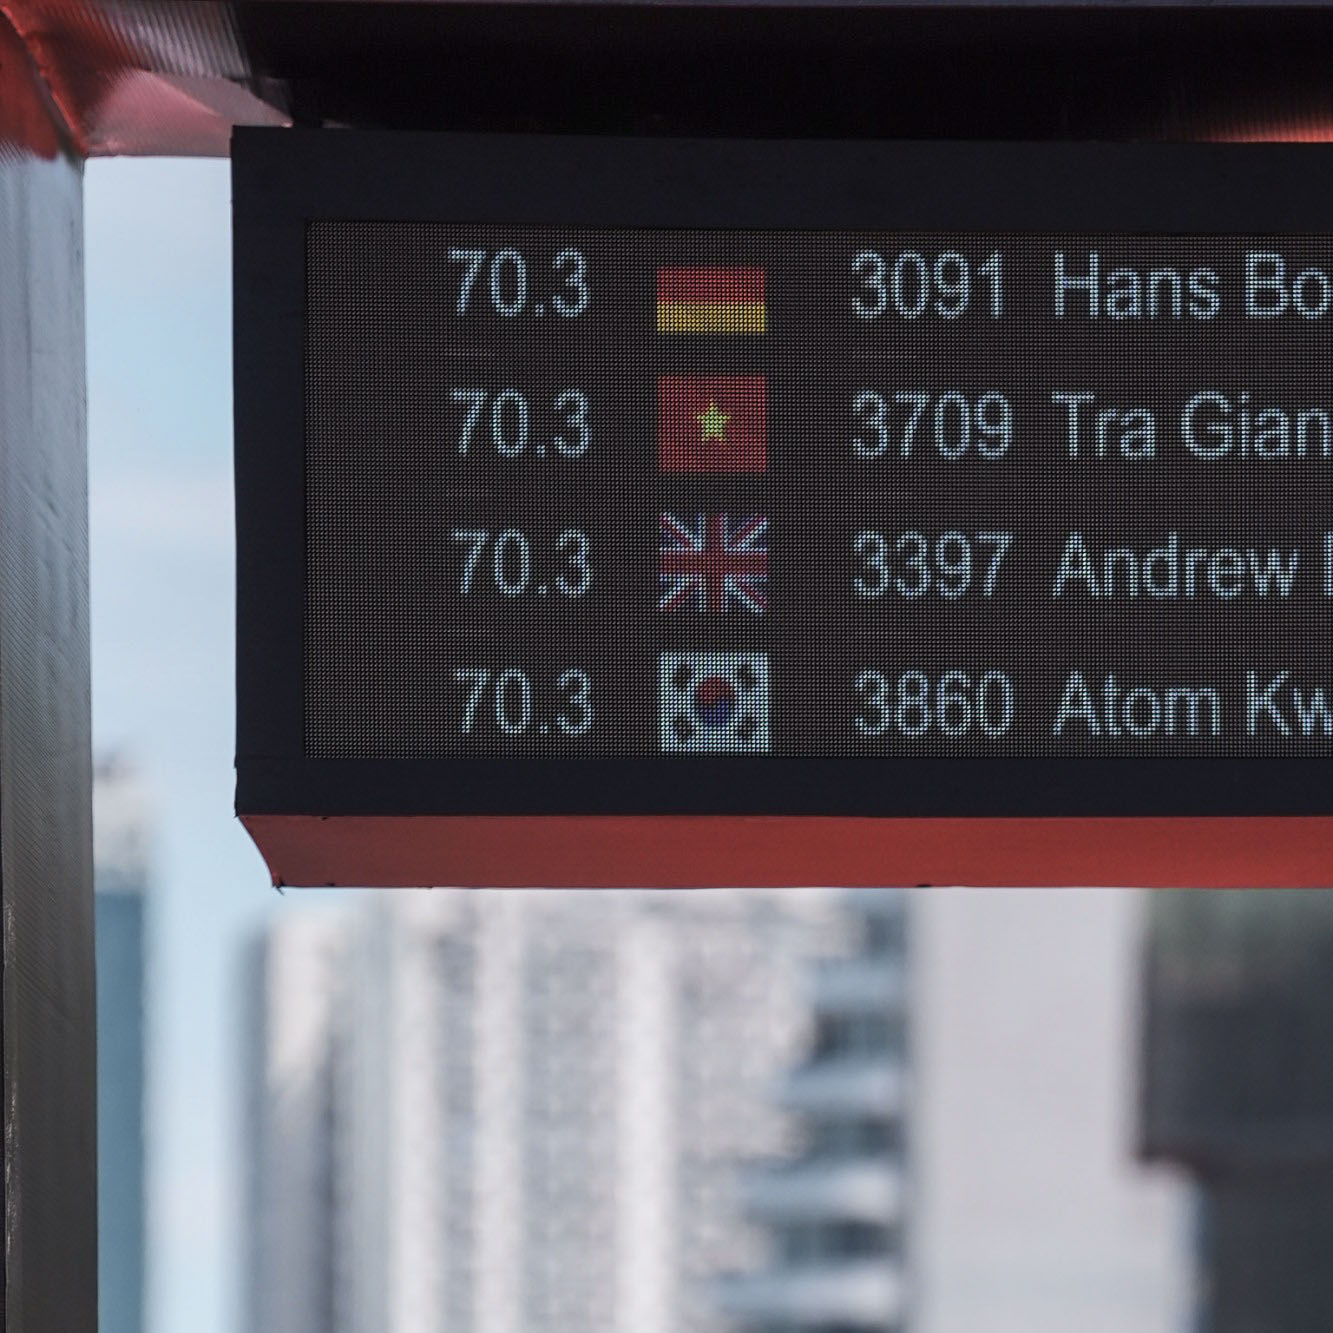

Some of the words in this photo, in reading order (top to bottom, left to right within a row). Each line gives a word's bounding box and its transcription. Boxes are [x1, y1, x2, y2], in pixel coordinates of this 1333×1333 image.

[448, 248, 591, 316] 70.3
[852, 251, 1005, 319] 3091
[1053, 251, 1221, 319] Hans
[450, 389, 592, 457] 70.3
[852, 390, 1013, 458] 3709
[1052, 391, 1157, 459] Tra
[453, 529, 592, 597] 70.3
[853, 531, 1013, 599] 3397
[1053, 532, 1298, 598] Andrew
[453, 668, 595, 735] 70.3
[853, 669, 1013, 737] 3860
[1052, 670, 1220, 737] Atom
